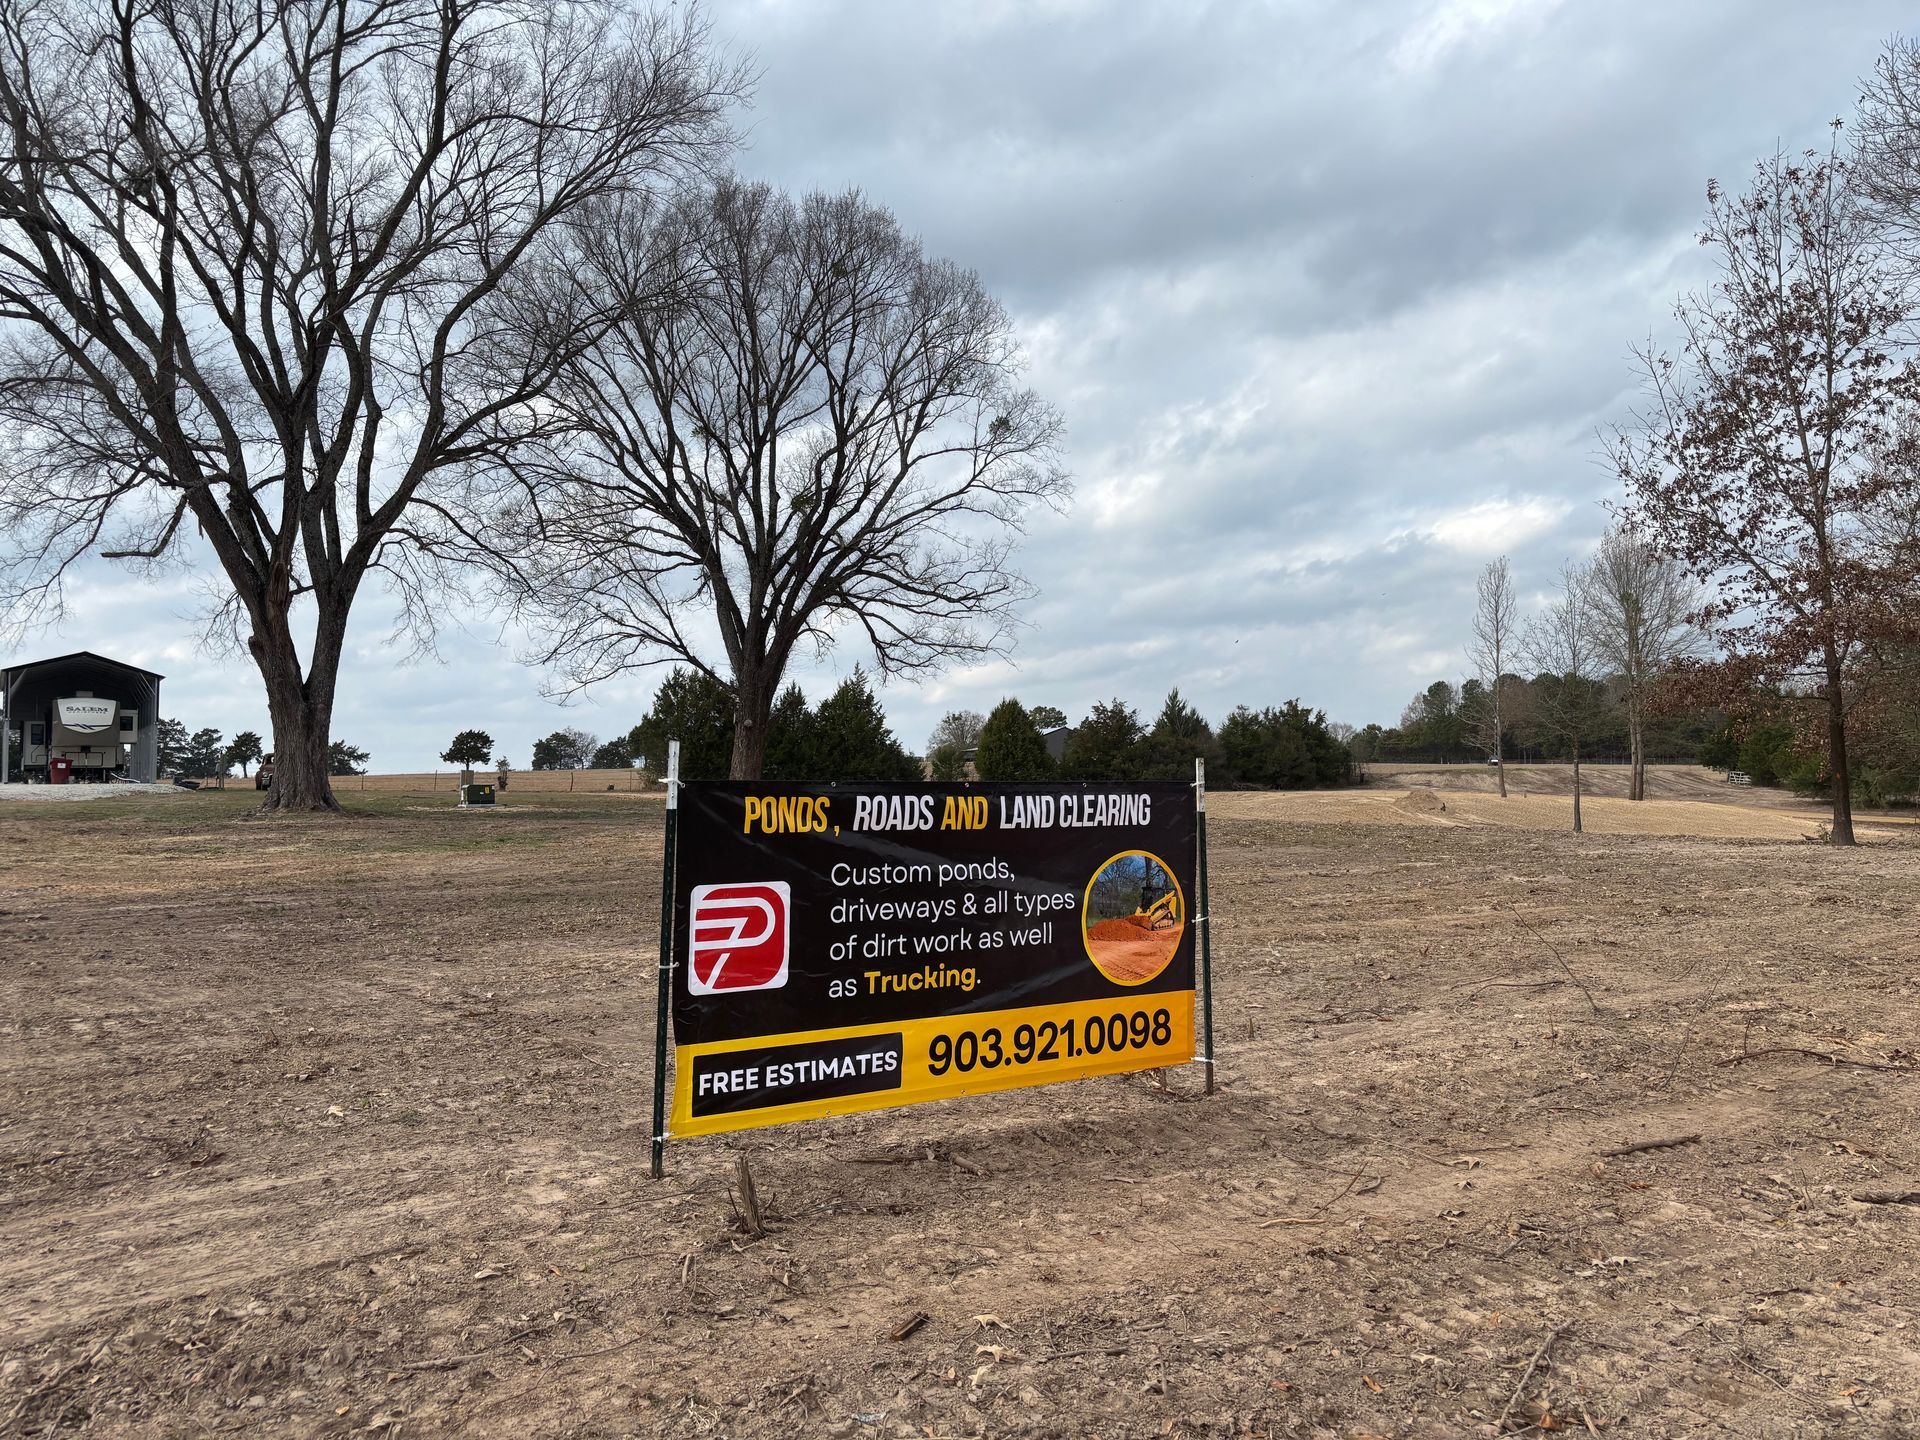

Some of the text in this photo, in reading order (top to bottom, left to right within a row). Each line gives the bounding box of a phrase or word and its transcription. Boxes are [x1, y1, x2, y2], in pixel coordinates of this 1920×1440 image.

[743, 793, 1151, 837] PONDS, ROADS AND LAND CLEARING
[831, 858, 1016, 887] Custom ponds,
[830, 890, 1075, 924] driveways & all types
[829, 921, 1052, 961] of dirt work as well
[828, 962, 981, 998] as Trucking.
[928, 1008, 1173, 1077] 903.921.0098
[698, 1051, 899, 1097] FREE ESTIMATES
